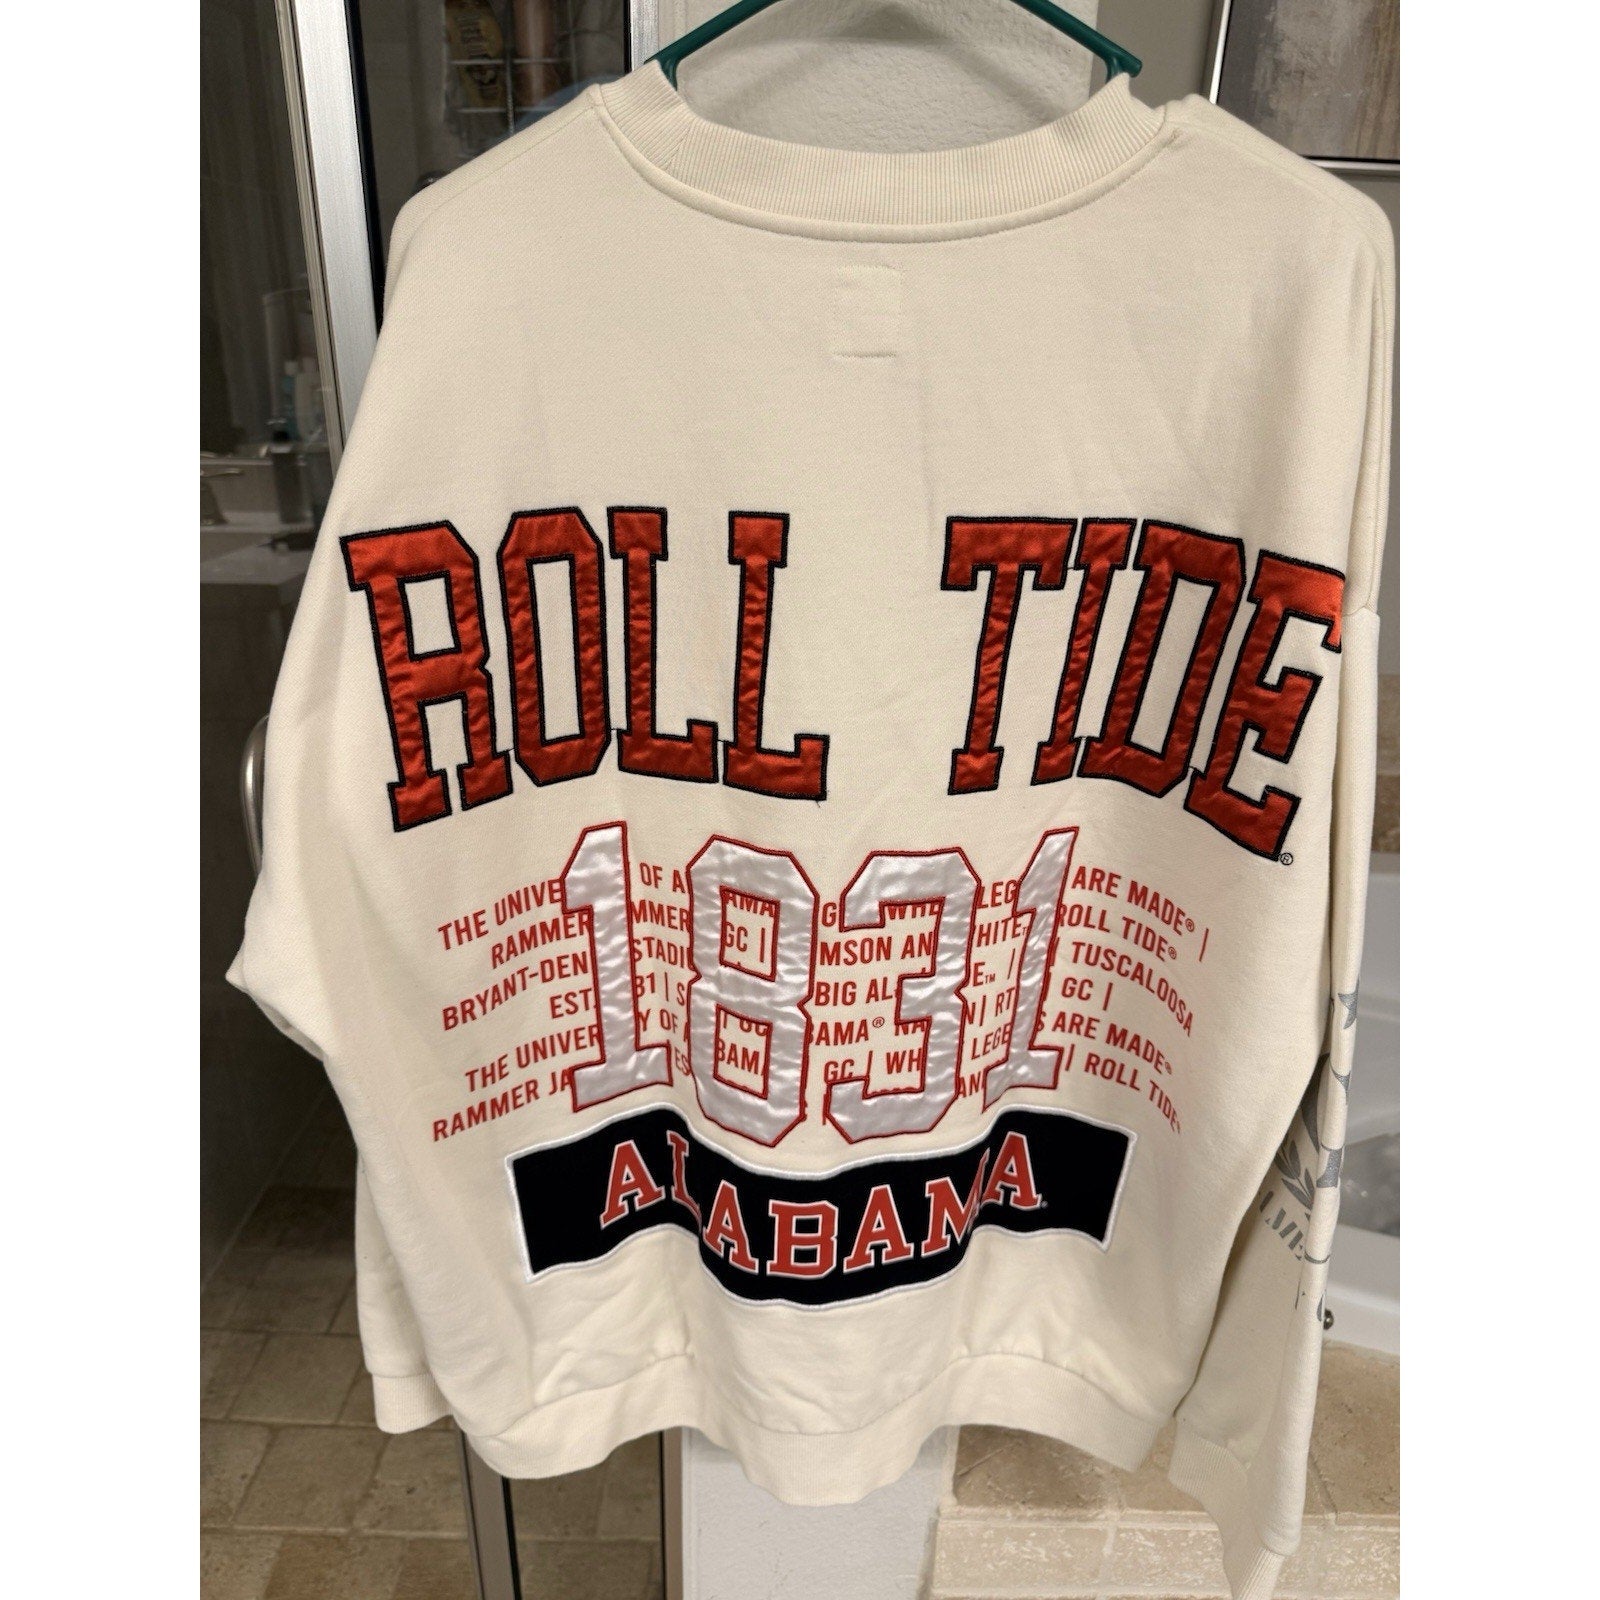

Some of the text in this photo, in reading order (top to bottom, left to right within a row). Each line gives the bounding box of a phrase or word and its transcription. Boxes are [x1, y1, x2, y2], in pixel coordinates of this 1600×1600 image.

[340, 506, 831, 833] ROLL
[941, 516, 1346, 861] TIDE
[438, 909, 489, 950] THE
[494, 878, 562, 926] UNIVE
[640, 862, 663, 889] OF
[976, 879, 1016, 909] LEG
[1071, 866, 1121, 898] ARE
[491, 912, 590, 970] RAMMER
[631, 899, 691, 932] MMER
[819, 936, 893, 967] MSON
[900, 931, 933, 960] AN
[976, 917, 1024, 948] HITE
[1059, 903, 1111, 933] ROLL
[442, 951, 589, 1031] BRYANT-DEN
[633, 936, 686, 969] STADI
[814, 980, 857, 1007] BIG
[1071, 941, 1194, 1038] TUSCALOOSA
[560, 821, 1080, 1147] 1831
[994, 986, 1016, 1018] RT
[1061, 977, 1095, 1003] GC
[464, 1053, 510, 1093] THE
[516, 1023, 601, 1069] UNIVER
[660, 1008, 679, 1034] OF
[717, 1037, 760, 1076] BAM
[886, 1048, 923, 1076] WH
[971, 1022, 1013, 1060] LEGE
[1051, 1010, 1101, 1040] ARE
[432, 1079, 540, 1142] RAMMER
[548, 1068, 573, 1095] JA
[959, 1071, 982, 1098] AN
[1084, 1052, 1141, 1092] ROLL
[600, 1130, 1042, 1278] ALABAMA
